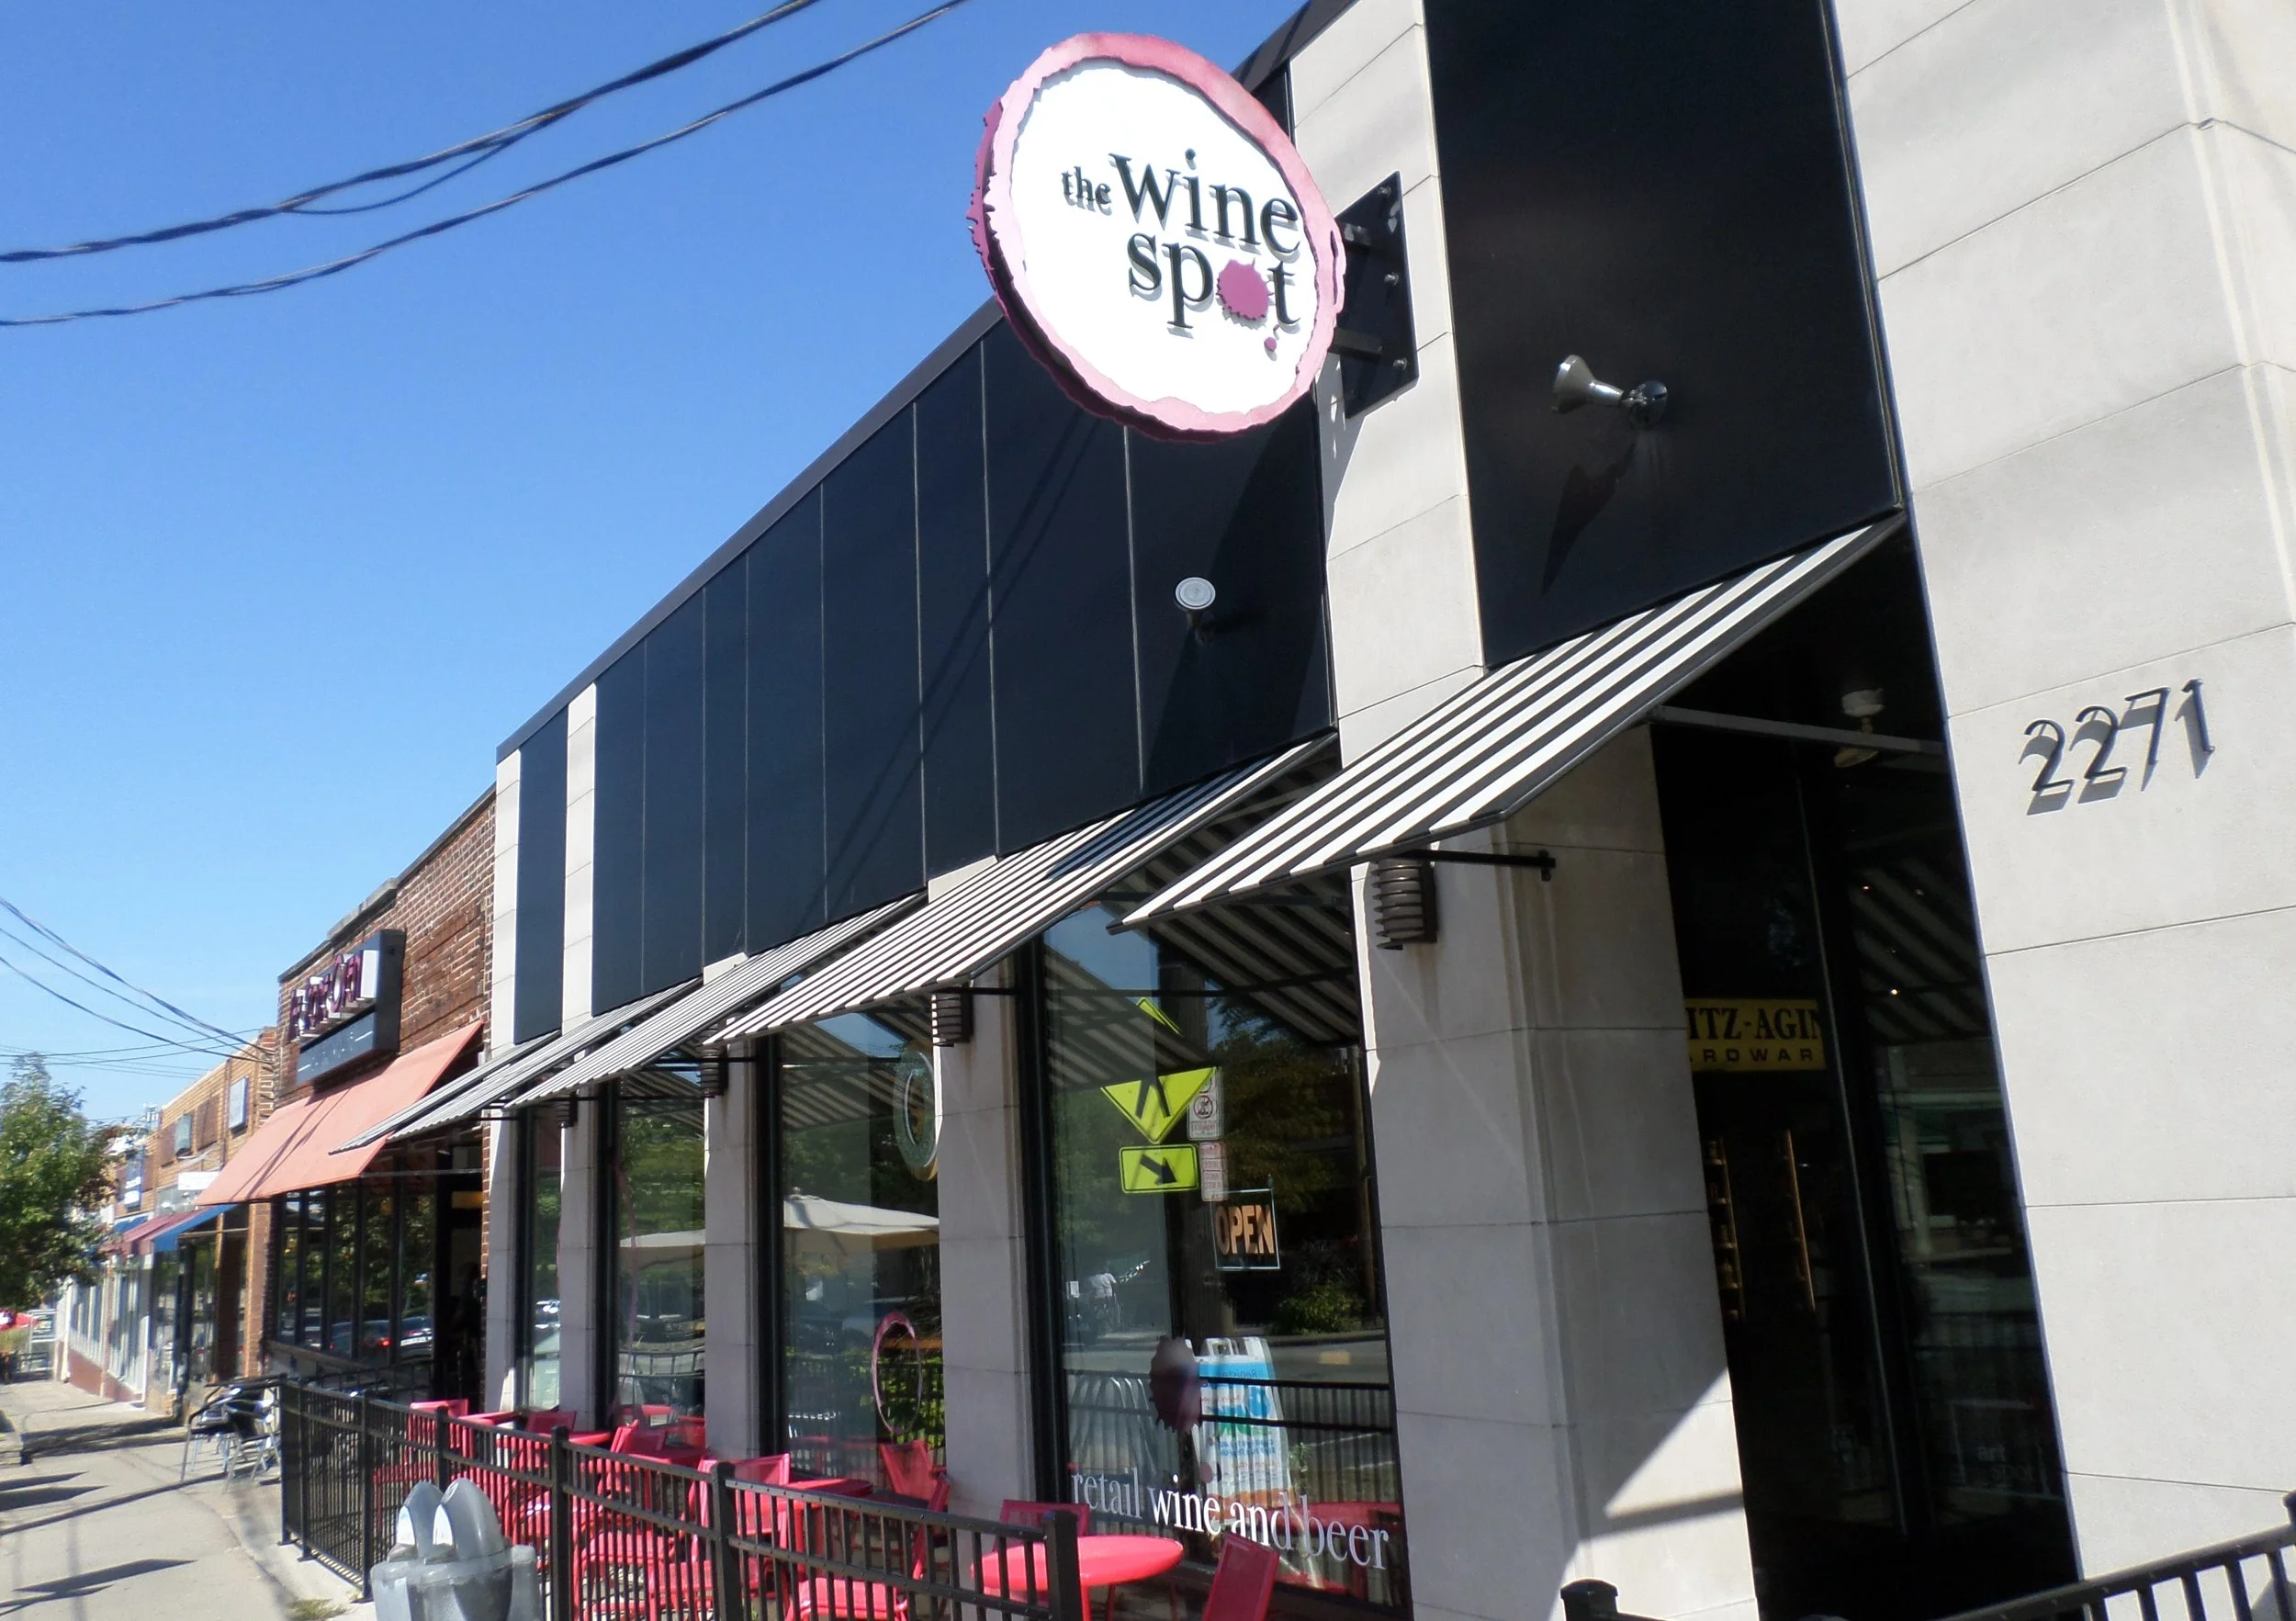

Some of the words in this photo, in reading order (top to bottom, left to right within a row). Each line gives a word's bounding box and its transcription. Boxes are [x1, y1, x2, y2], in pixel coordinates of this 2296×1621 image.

[1061, 165, 1112, 207] the
[2022, 678, 2215, 794] 2271
[1690, 1048, 1813, 1063] RDWAR
[1215, 1204, 1275, 1255] OPEN
[1070, 1467, 1142, 1519] retail
[1148, 1473, 1222, 1537] wine
[1229, 1492, 1295, 1551] and
[1300, 1494, 1390, 1570] beer
